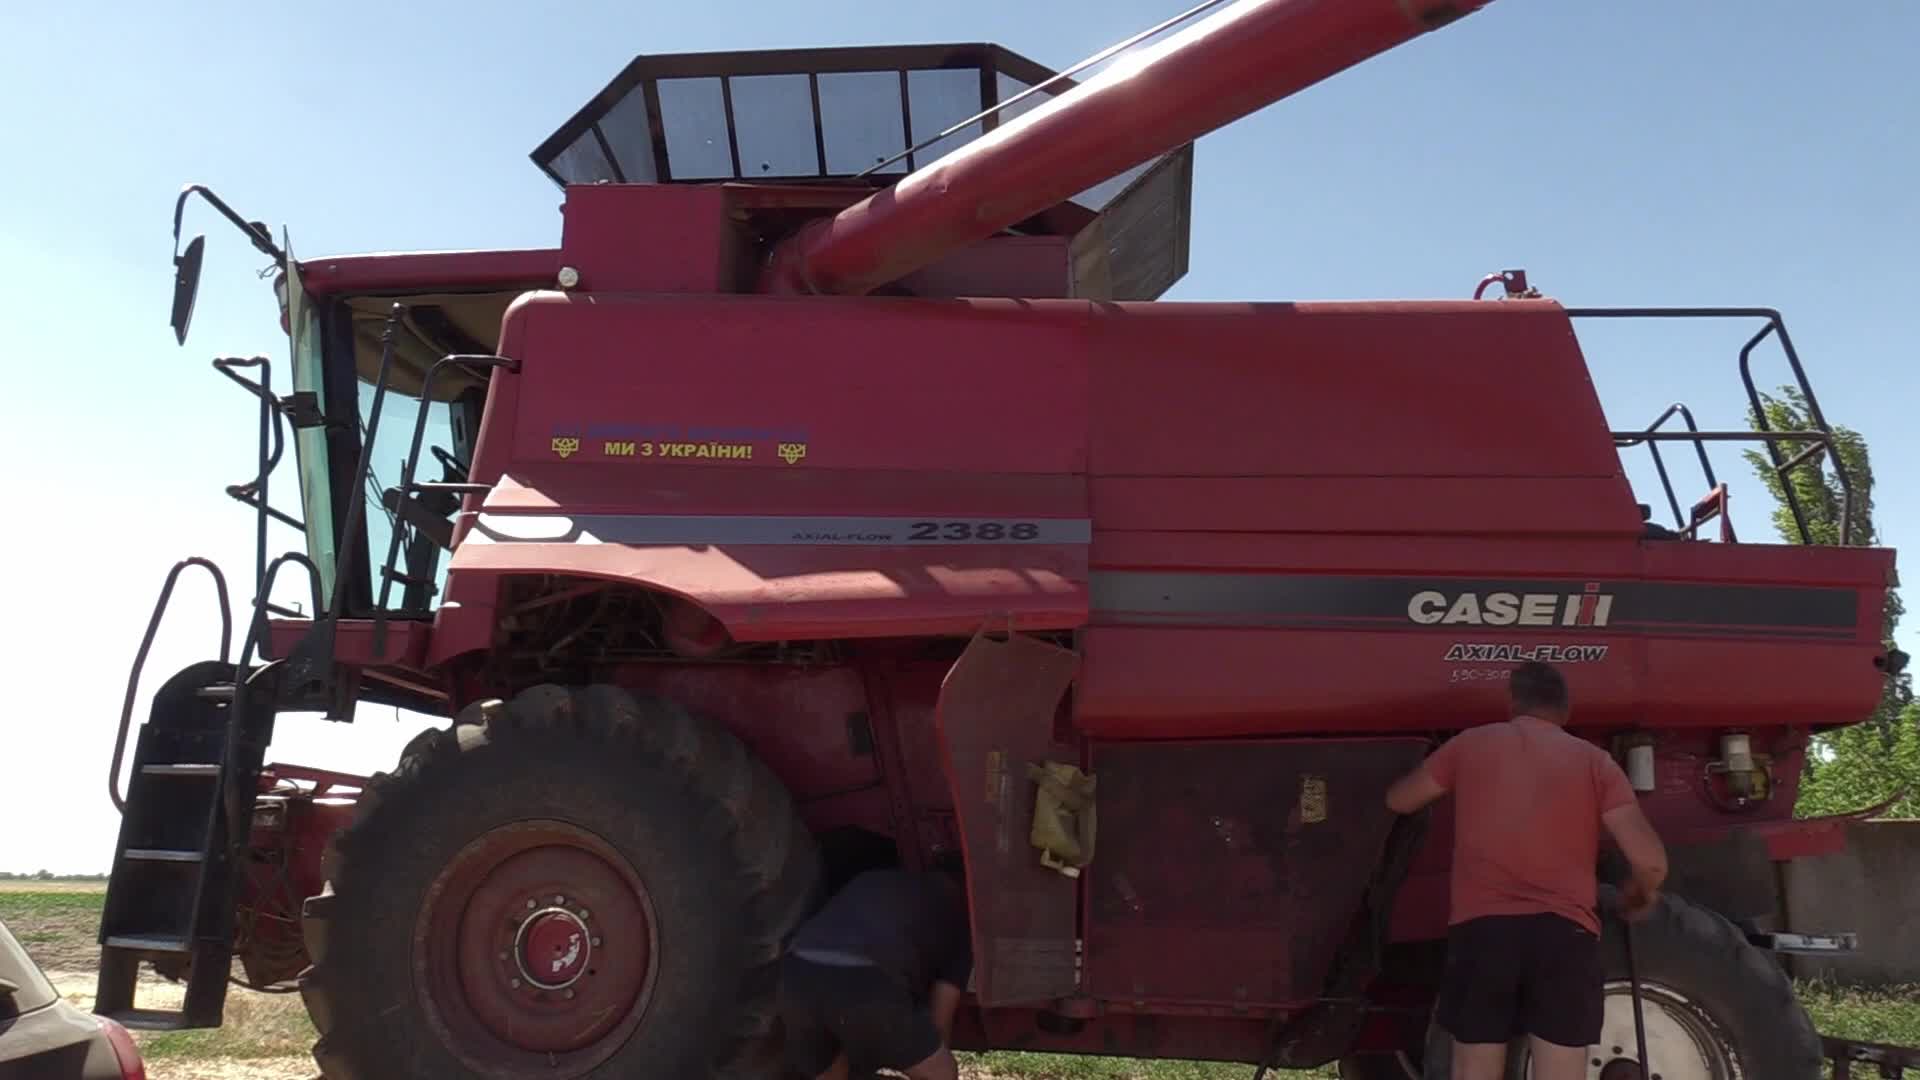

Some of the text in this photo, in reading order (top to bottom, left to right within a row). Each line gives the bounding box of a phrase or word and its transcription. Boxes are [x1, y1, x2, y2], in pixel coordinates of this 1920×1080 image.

[604, 441, 635, 456] МИ
[659, 441, 753, 459] УКРАЇНИ!
[791, 521, 1040, 542] AXIAL-FLOW 2388
[1407, 590, 1559, 626] CASE
[1443, 643, 1609, 663] AXIAL-FLOW
